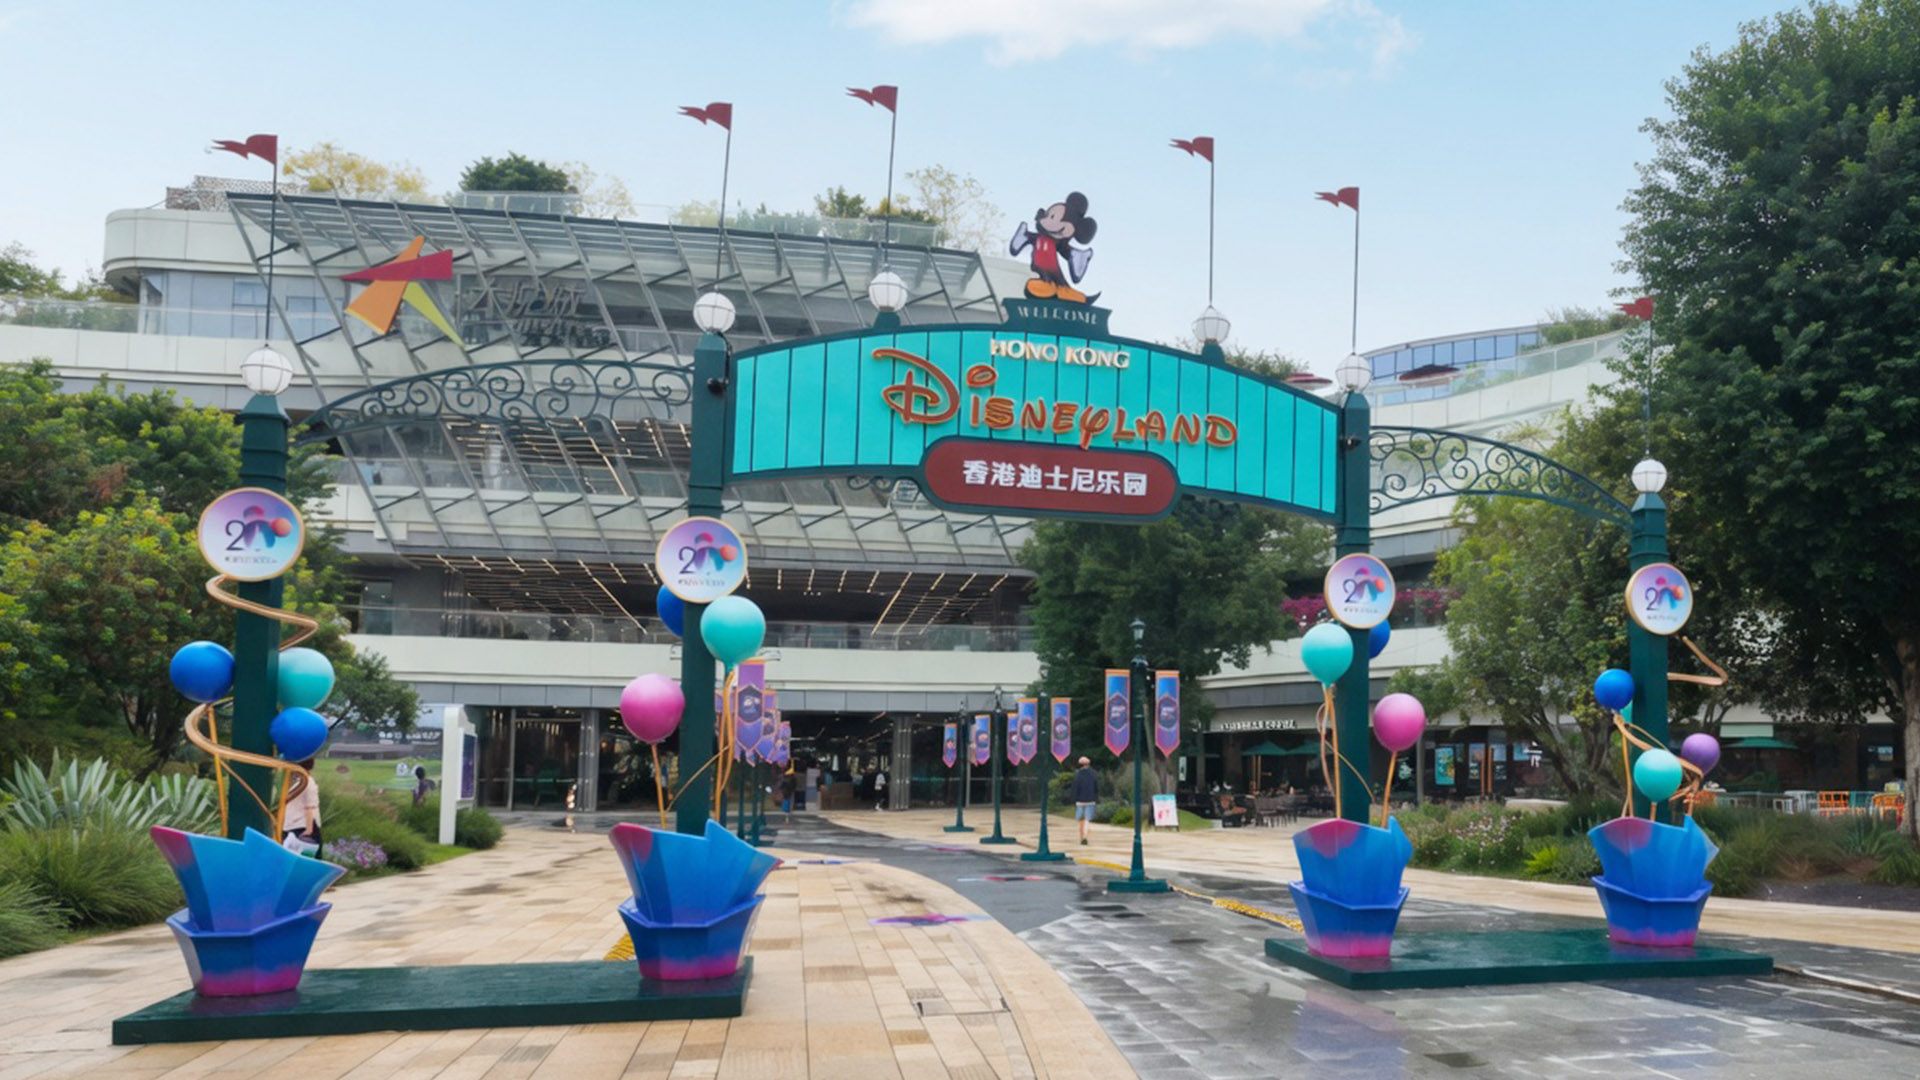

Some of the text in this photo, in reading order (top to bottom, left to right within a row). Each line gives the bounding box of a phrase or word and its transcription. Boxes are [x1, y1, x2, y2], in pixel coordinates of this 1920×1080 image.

[1017, 306, 1097, 325] WELCOME
[990, 338, 1131, 369] HONG KONG
[962, 459, 1148, 497] 香港迪士尼乐园
